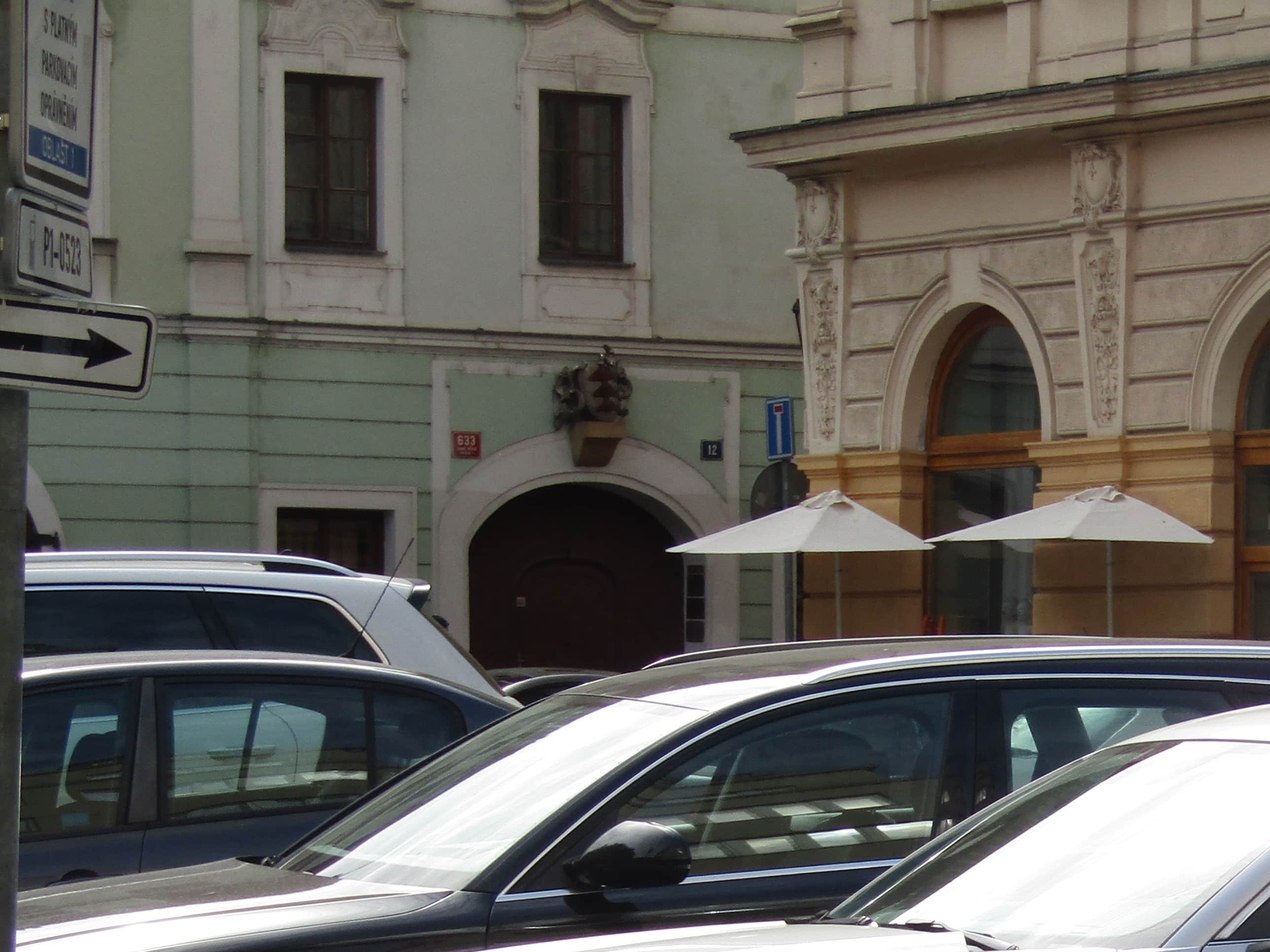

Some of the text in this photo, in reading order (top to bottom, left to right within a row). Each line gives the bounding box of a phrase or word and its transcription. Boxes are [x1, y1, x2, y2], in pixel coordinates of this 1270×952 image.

[43, 7, 77, 47] S PLATNÝM
[41, 48, 78, 90] PARKOVACÍM
[43, 226, 81, 276] P1-0523
[457, 435, 476, 446] 633
[707, 444, 718, 456] 12
